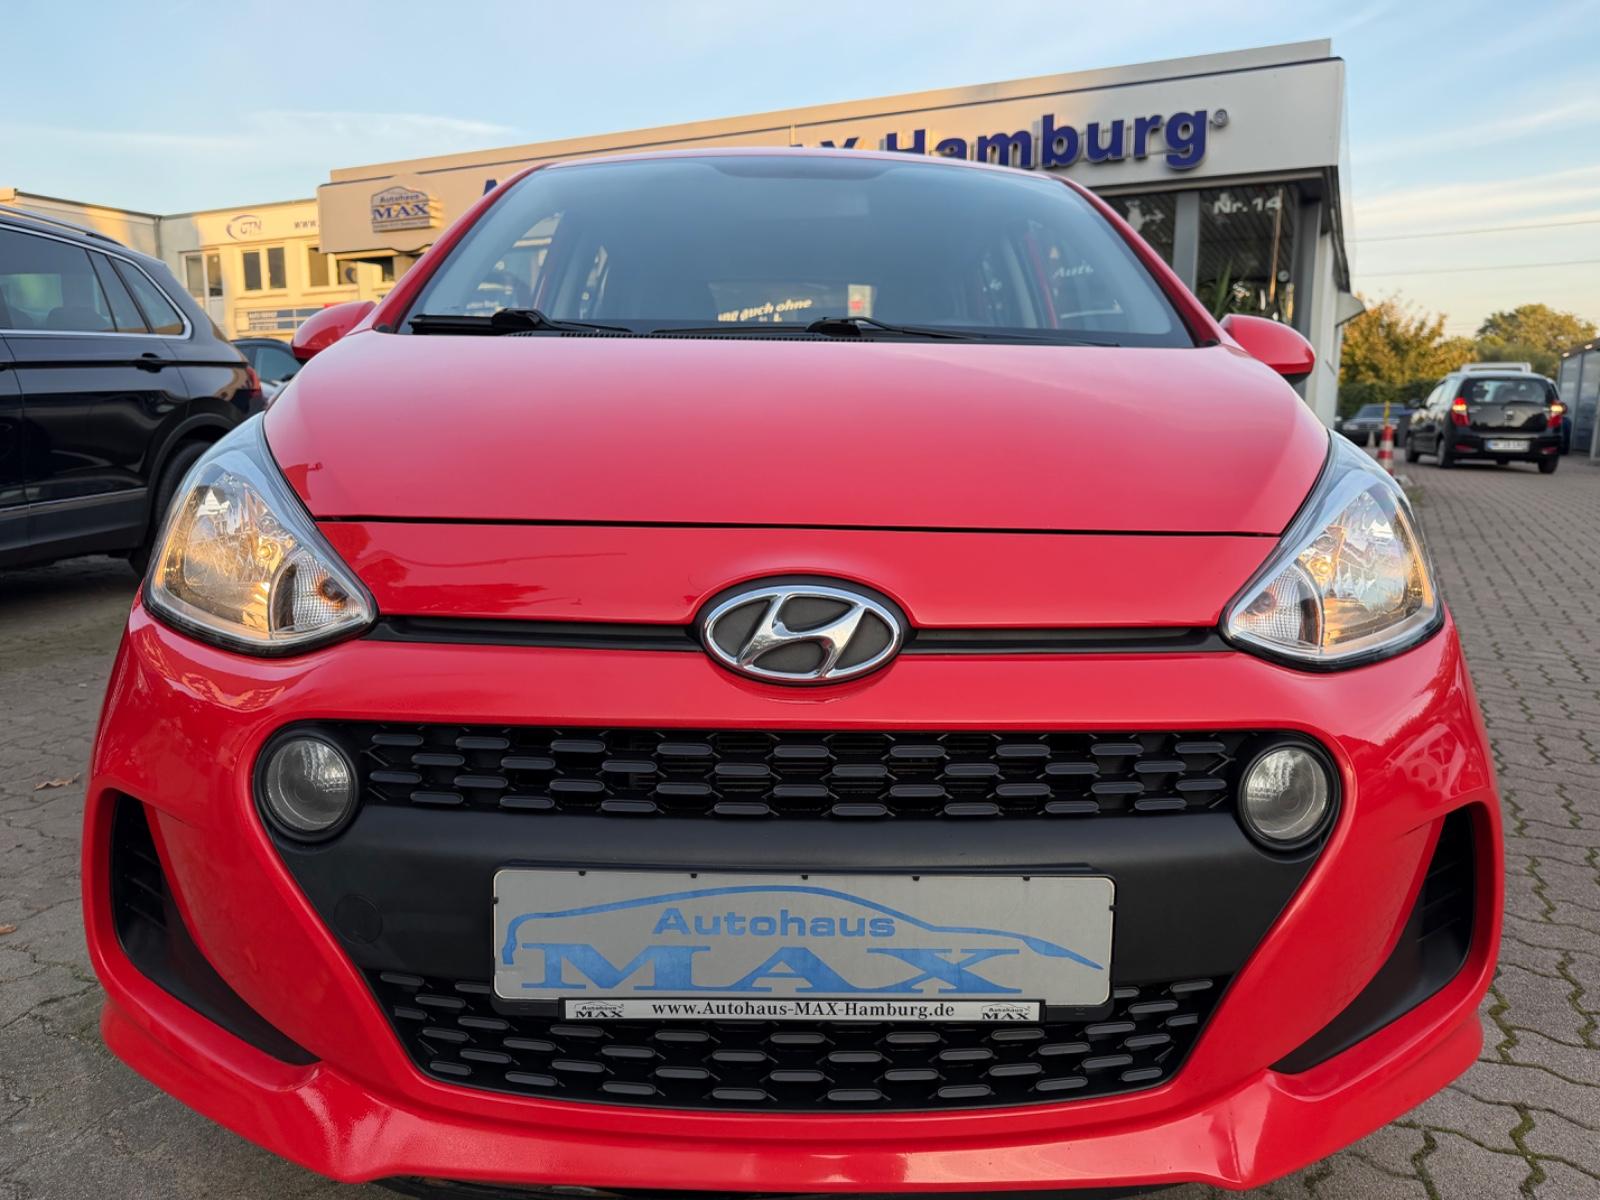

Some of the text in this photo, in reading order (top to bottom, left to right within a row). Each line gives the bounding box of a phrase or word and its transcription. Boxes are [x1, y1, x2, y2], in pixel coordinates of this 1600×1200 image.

[373, 204, 428, 220] MAX
[1213, 200, 1248, 214] Nr.
[739, 302, 774, 322] auch
[775, 299, 813, 313] ohne
[653, 907, 897, 938] Autohaus
[521, 943, 1023, 994] MAX
[652, 1002, 955, 1019] www.Autohaus-MAX-Hamburg.de
